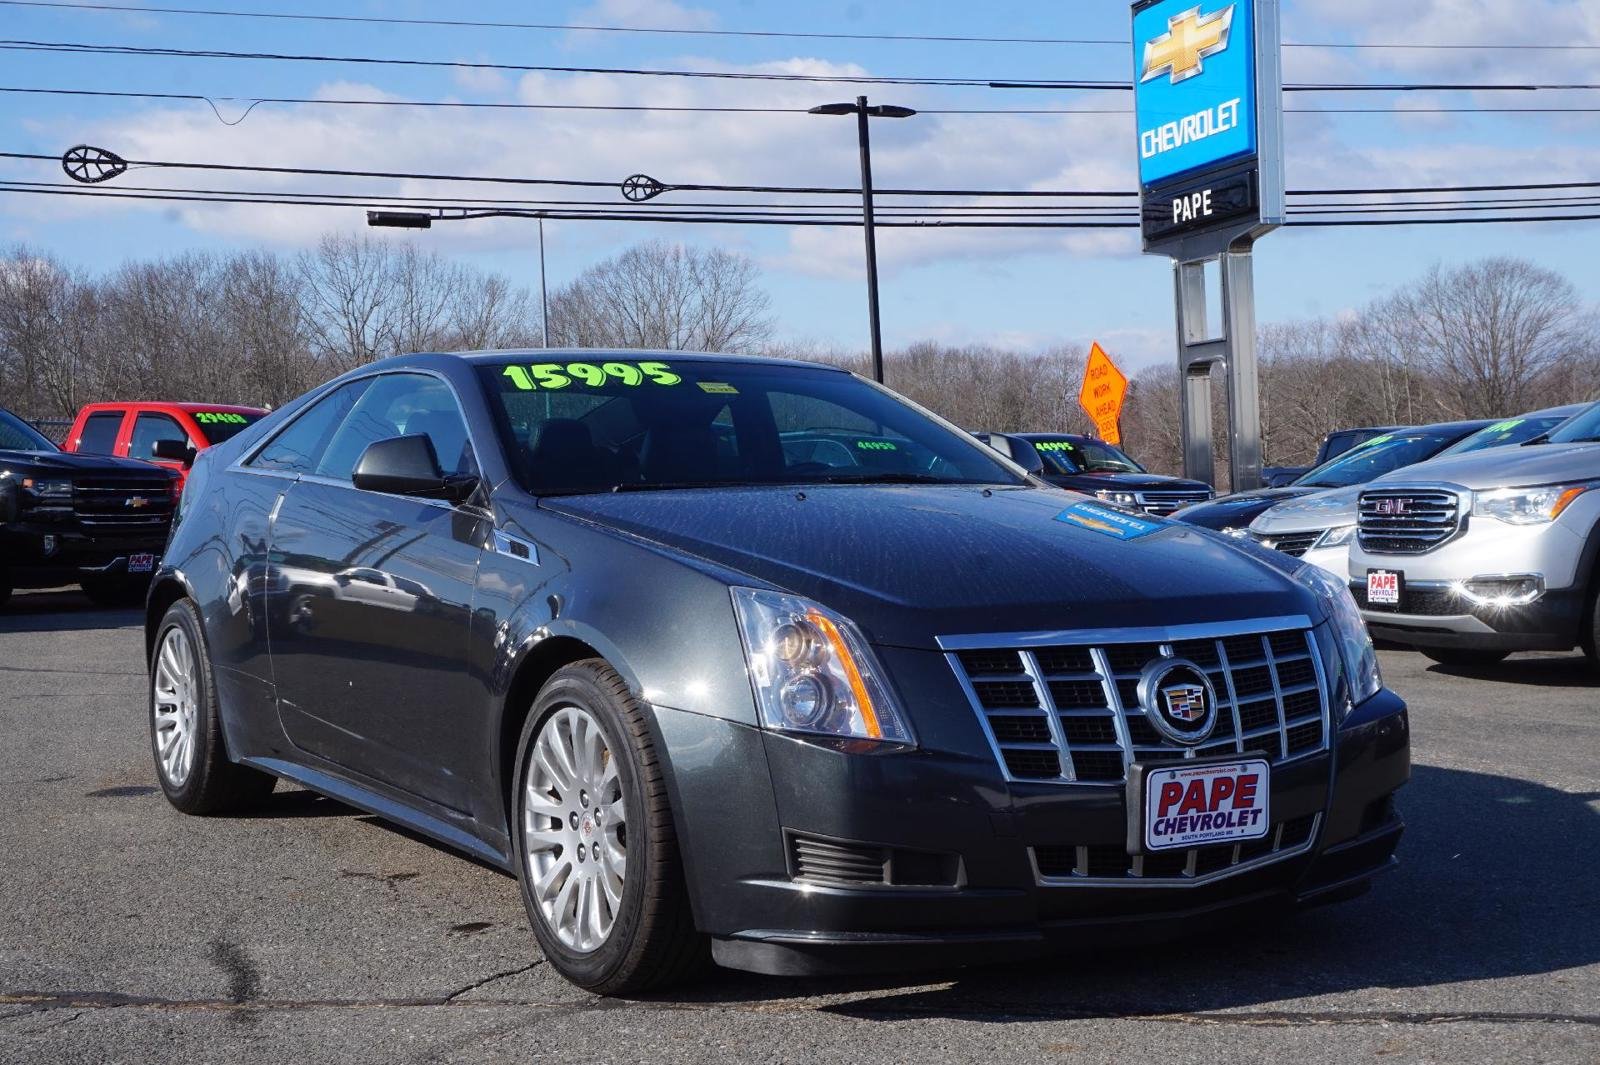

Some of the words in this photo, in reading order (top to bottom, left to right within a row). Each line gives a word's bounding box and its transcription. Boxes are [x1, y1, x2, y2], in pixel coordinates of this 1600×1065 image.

[1141, 98, 1240, 159] CHEVROLET
[1172, 189, 1213, 224] PAPE
[503, 362, 682, 390] 15995
[1090, 364, 1108, 381] ROAD
[1093, 383, 1110, 399] WORK
[1096, 399, 1116, 417] AHEAD
[1035, 442, 1074, 451] 44995
[1376, 499, 1413, 515] GMC
[1370, 576, 1396, 589] PAPE
[1157, 774, 1259, 818] PAPE
[1153, 808, 1262, 836] CHEVROLET
